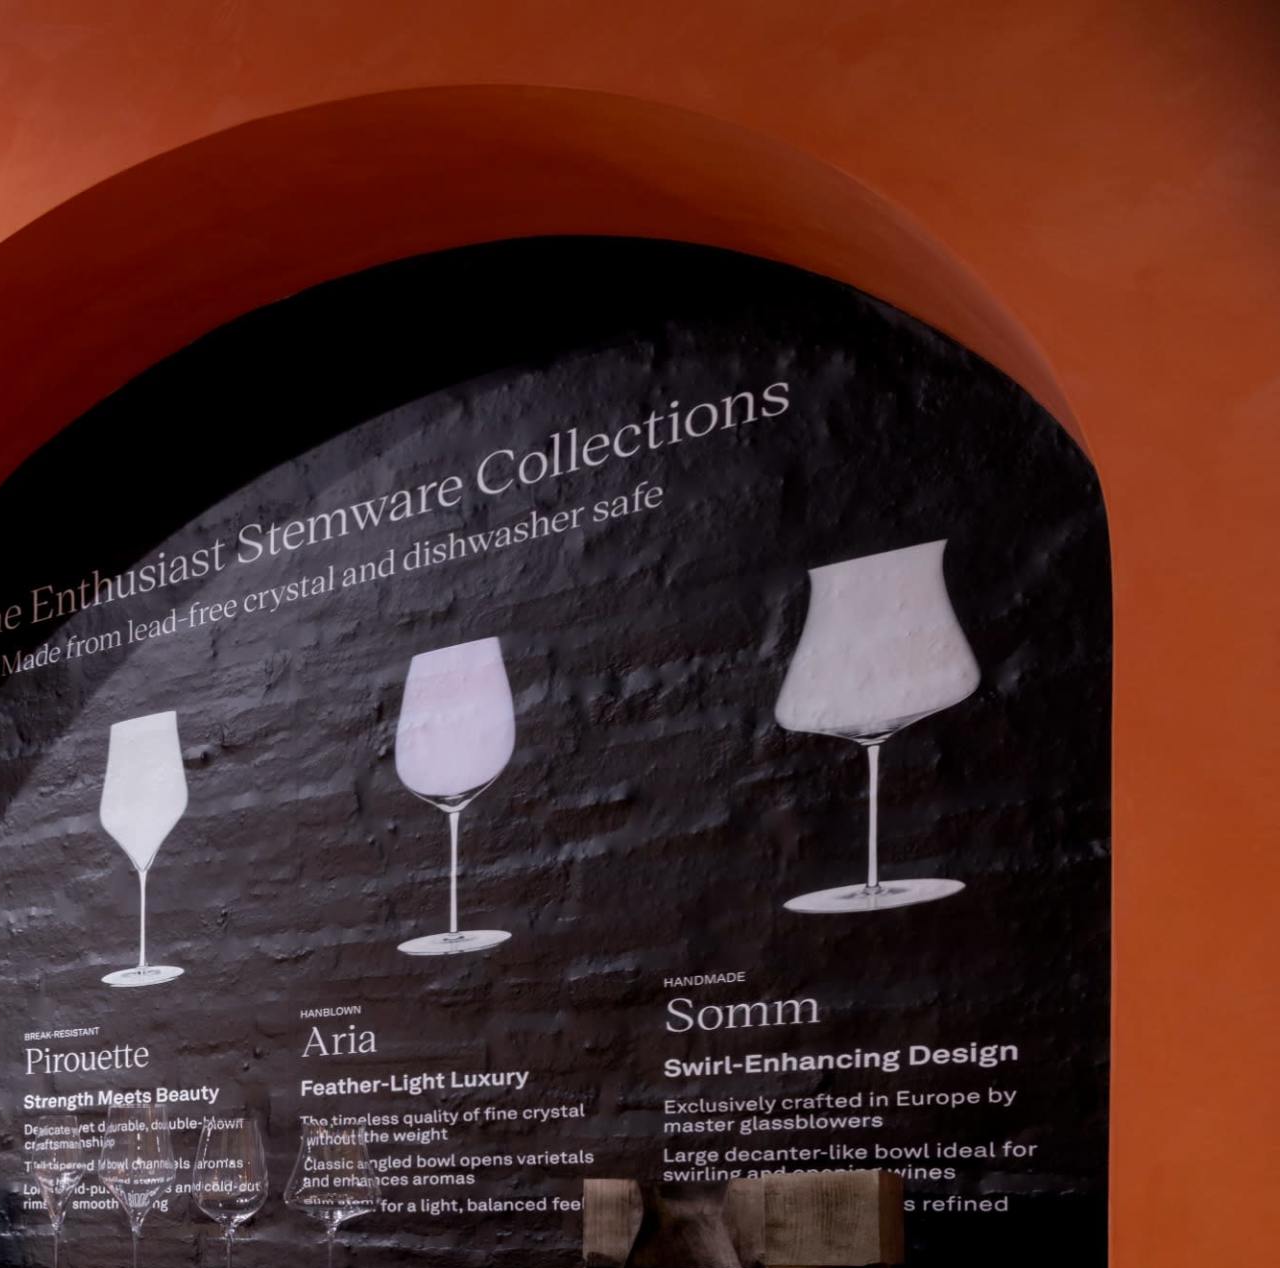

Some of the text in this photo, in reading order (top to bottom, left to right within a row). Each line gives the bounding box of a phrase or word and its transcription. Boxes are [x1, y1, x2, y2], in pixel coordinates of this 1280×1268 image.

[30, 538, 226, 625] Enthusiast
[237, 474, 463, 564] Stemware
[476, 381, 791, 495] Collections
[1, 481, 664, 676] Made from lead-free crystal and dishwasher safe
[663, 971, 746, 988] HANDMADE
[300, 1005, 361, 1018] HANBLOWN
[665, 995, 821, 1033] Somm
[24, 1026, 100, 1042] BREAK-RESISTANT
[301, 1024, 377, 1058] Aria
[24, 1043, 150, 1076] Pirouette
[664, 1042, 1019, 1077] Swirl-Enhancing Design
[301, 1070, 530, 1097] Feather-Light Luxury
[23, 1085, 220, 1110] Strength Meets Beauty
[664, 1087, 1017, 1115] Exclusively crafted in Europe by
[403, 1109, 459, 1128] quality
[463, 1107, 481, 1122] of
[483, 1106, 518, 1122] fine
[523, 1103, 585, 1123] crystal
[664, 1114, 884, 1135] master glassblowers
[364, 1129, 389, 1143] the
[393, 1127, 449, 1145] weight
[303, 1156, 354, 1171] Classic
[416, 1152, 456, 1168] bowl
[460, 1154, 513, 1171] opens
[517, 1150, 595, 1166] varietals
[663, 1140, 1038, 1166] Large decanter-like bowl ideal for
[303, 1174, 330, 1188] and
[412, 1172, 476, 1186] aromas
[663, 1165, 741, 1182] swirling
[72, 1198, 119, 1209] smooth
[380, 1199, 405, 1213] for
[408, 1202, 417, 1213] a
[420, 1198, 464, 1215] light,
[467, 1197, 547, 1212] balanced
[922, 1195, 1009, 1212] refined
